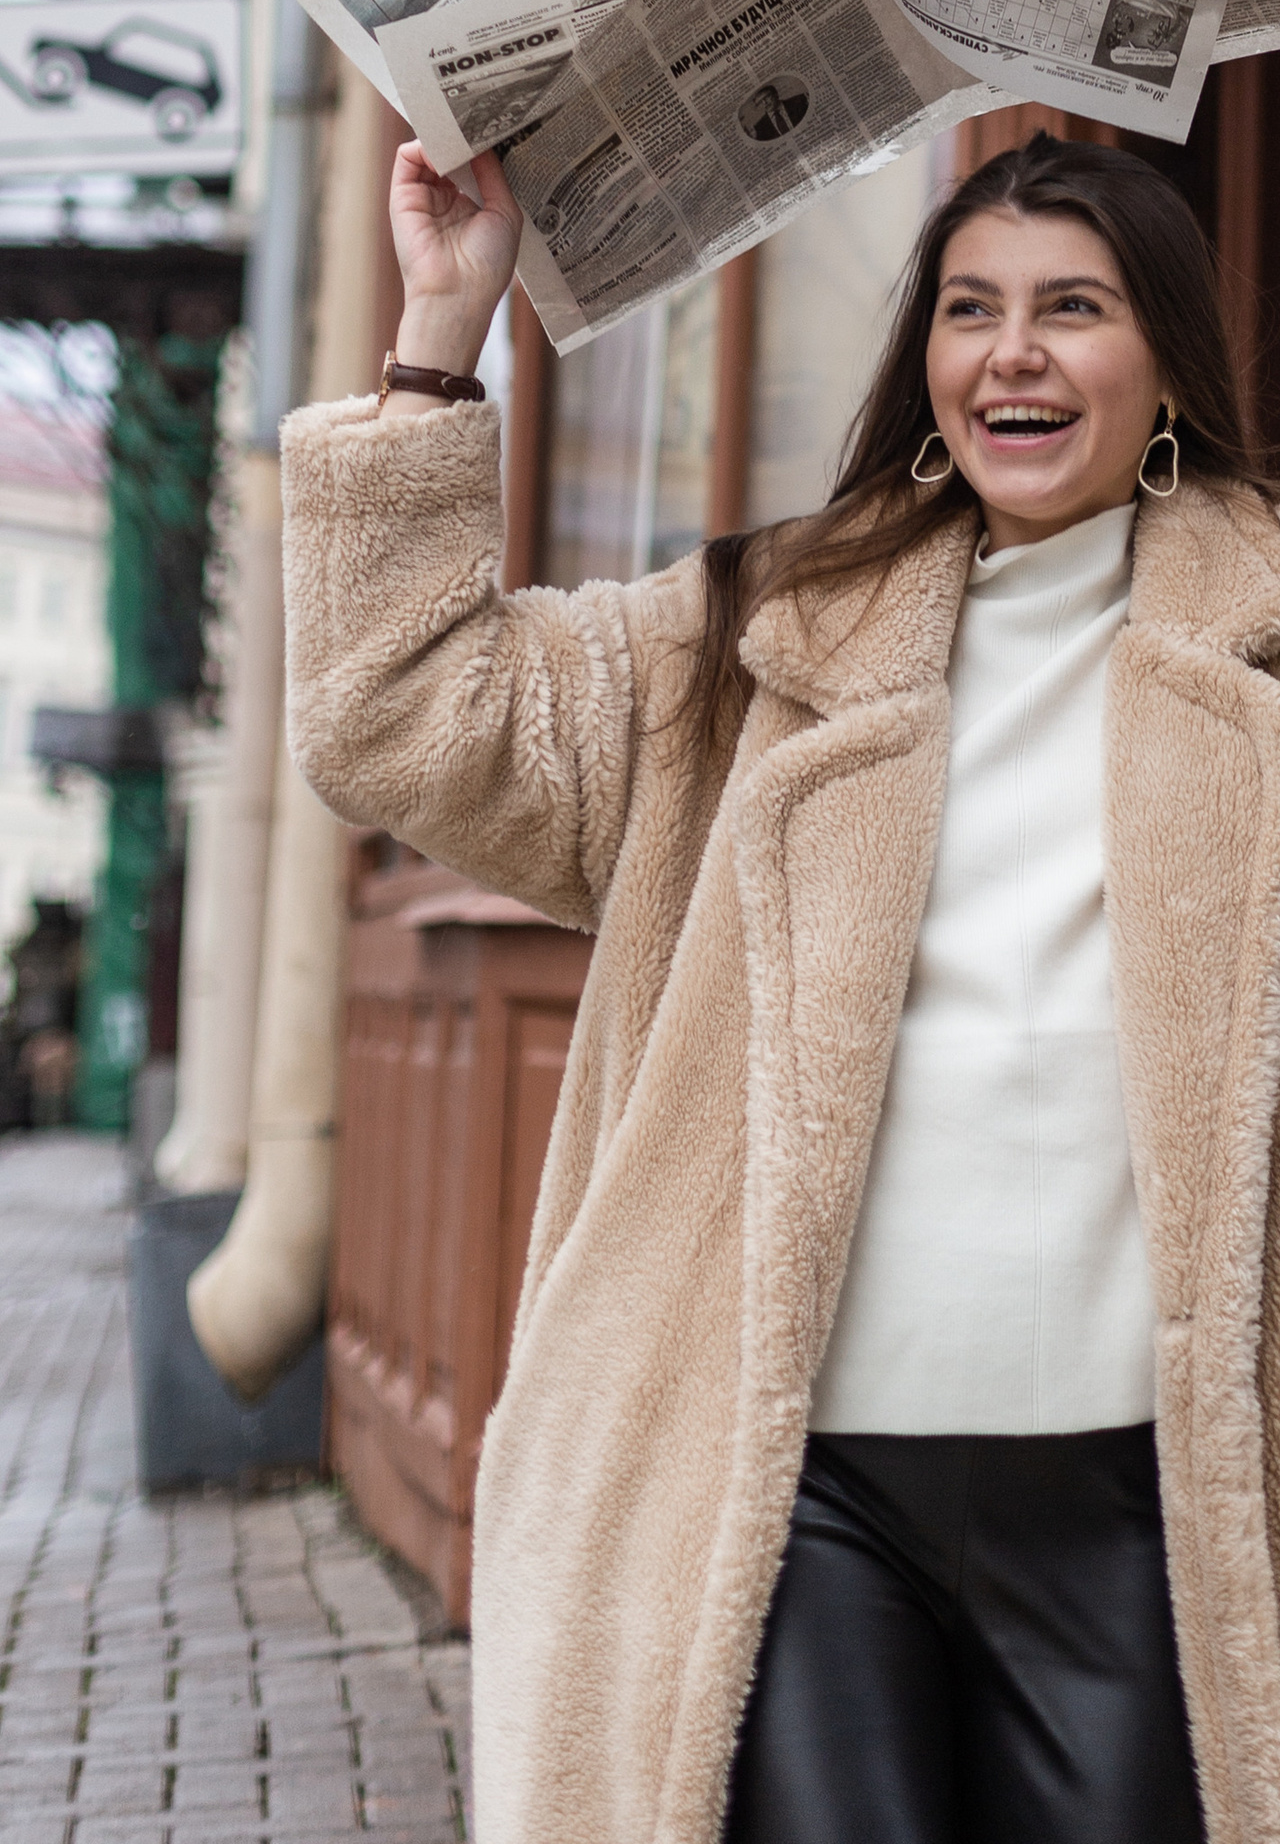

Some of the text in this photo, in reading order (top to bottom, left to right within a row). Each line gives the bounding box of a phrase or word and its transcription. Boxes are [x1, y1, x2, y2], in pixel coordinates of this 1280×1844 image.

[429, 47, 436, 59] 4
[438, 28, 560, 77] NON-STOP
[670, 25, 735, 79] МРАЧНОЕ
[699, 36, 744, 73] Миллиардер
[743, 17, 772, 41] сравнил
[732, 28, 771, 60] событиями
[770, 9, 795, 32] Второй
[1134, 82, 1169, 104] 30 стр.
